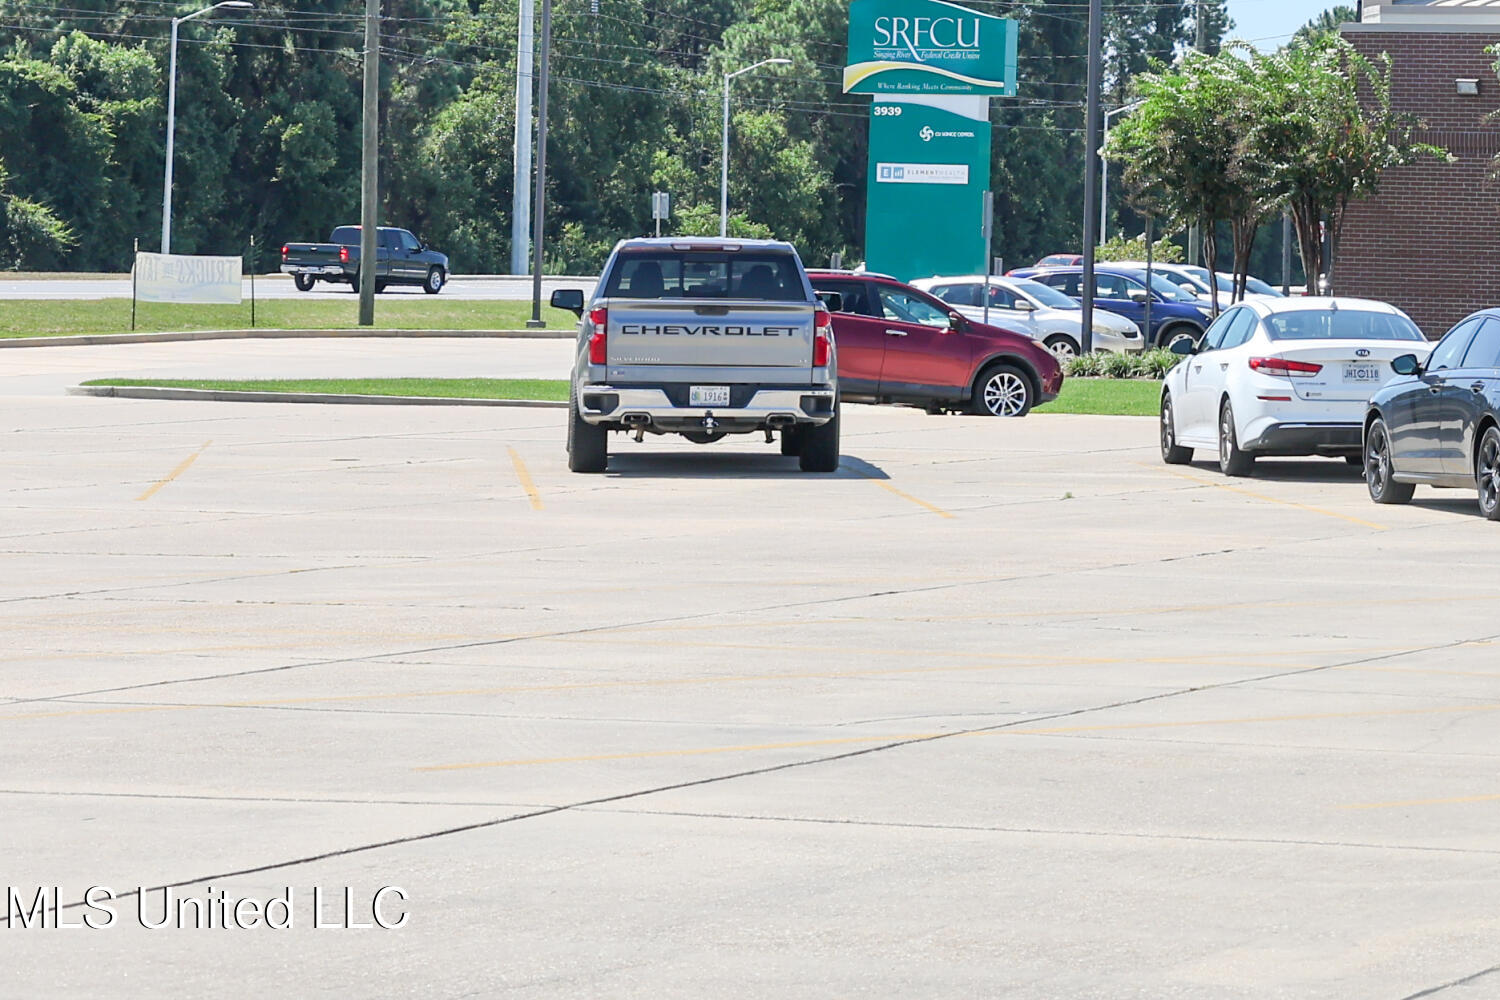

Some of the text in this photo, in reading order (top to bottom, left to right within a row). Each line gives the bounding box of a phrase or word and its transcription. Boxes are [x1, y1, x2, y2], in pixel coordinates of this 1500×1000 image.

[873, 16, 980, 61] SRFCU
[874, 106, 902, 116] 3939
[621, 325, 799, 337] CHEVROLET
[703, 391, 723, 402] 1916
